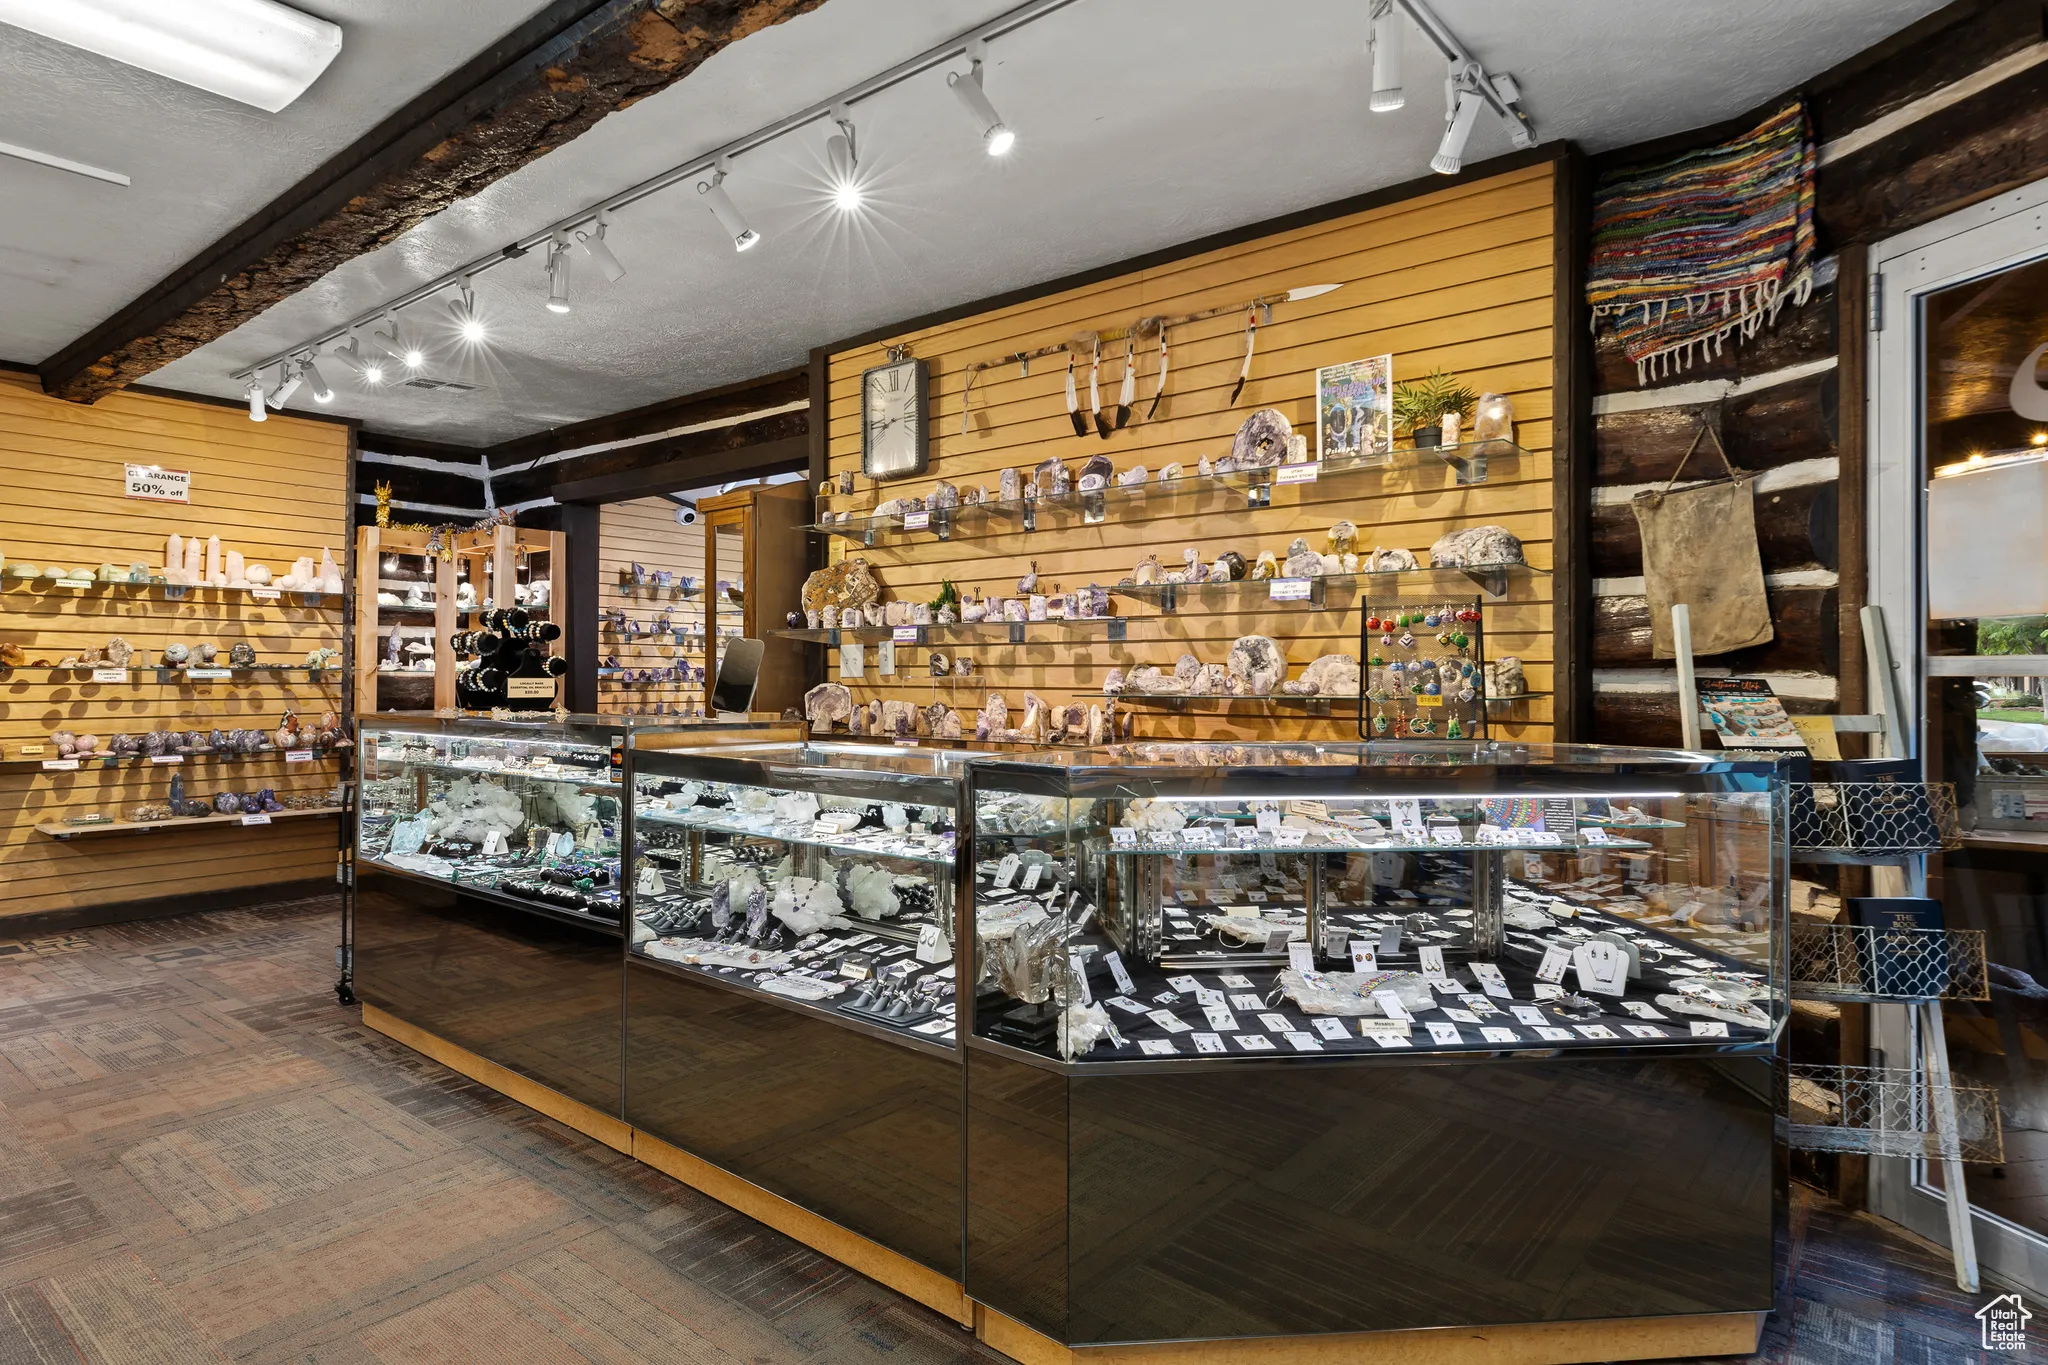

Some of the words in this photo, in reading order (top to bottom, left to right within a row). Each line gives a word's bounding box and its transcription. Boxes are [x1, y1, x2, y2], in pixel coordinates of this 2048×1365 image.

[128, 470, 187, 482] CLARANCE
[132, 482, 165, 495] 50%
[1895, 913, 1914, 921] THE
